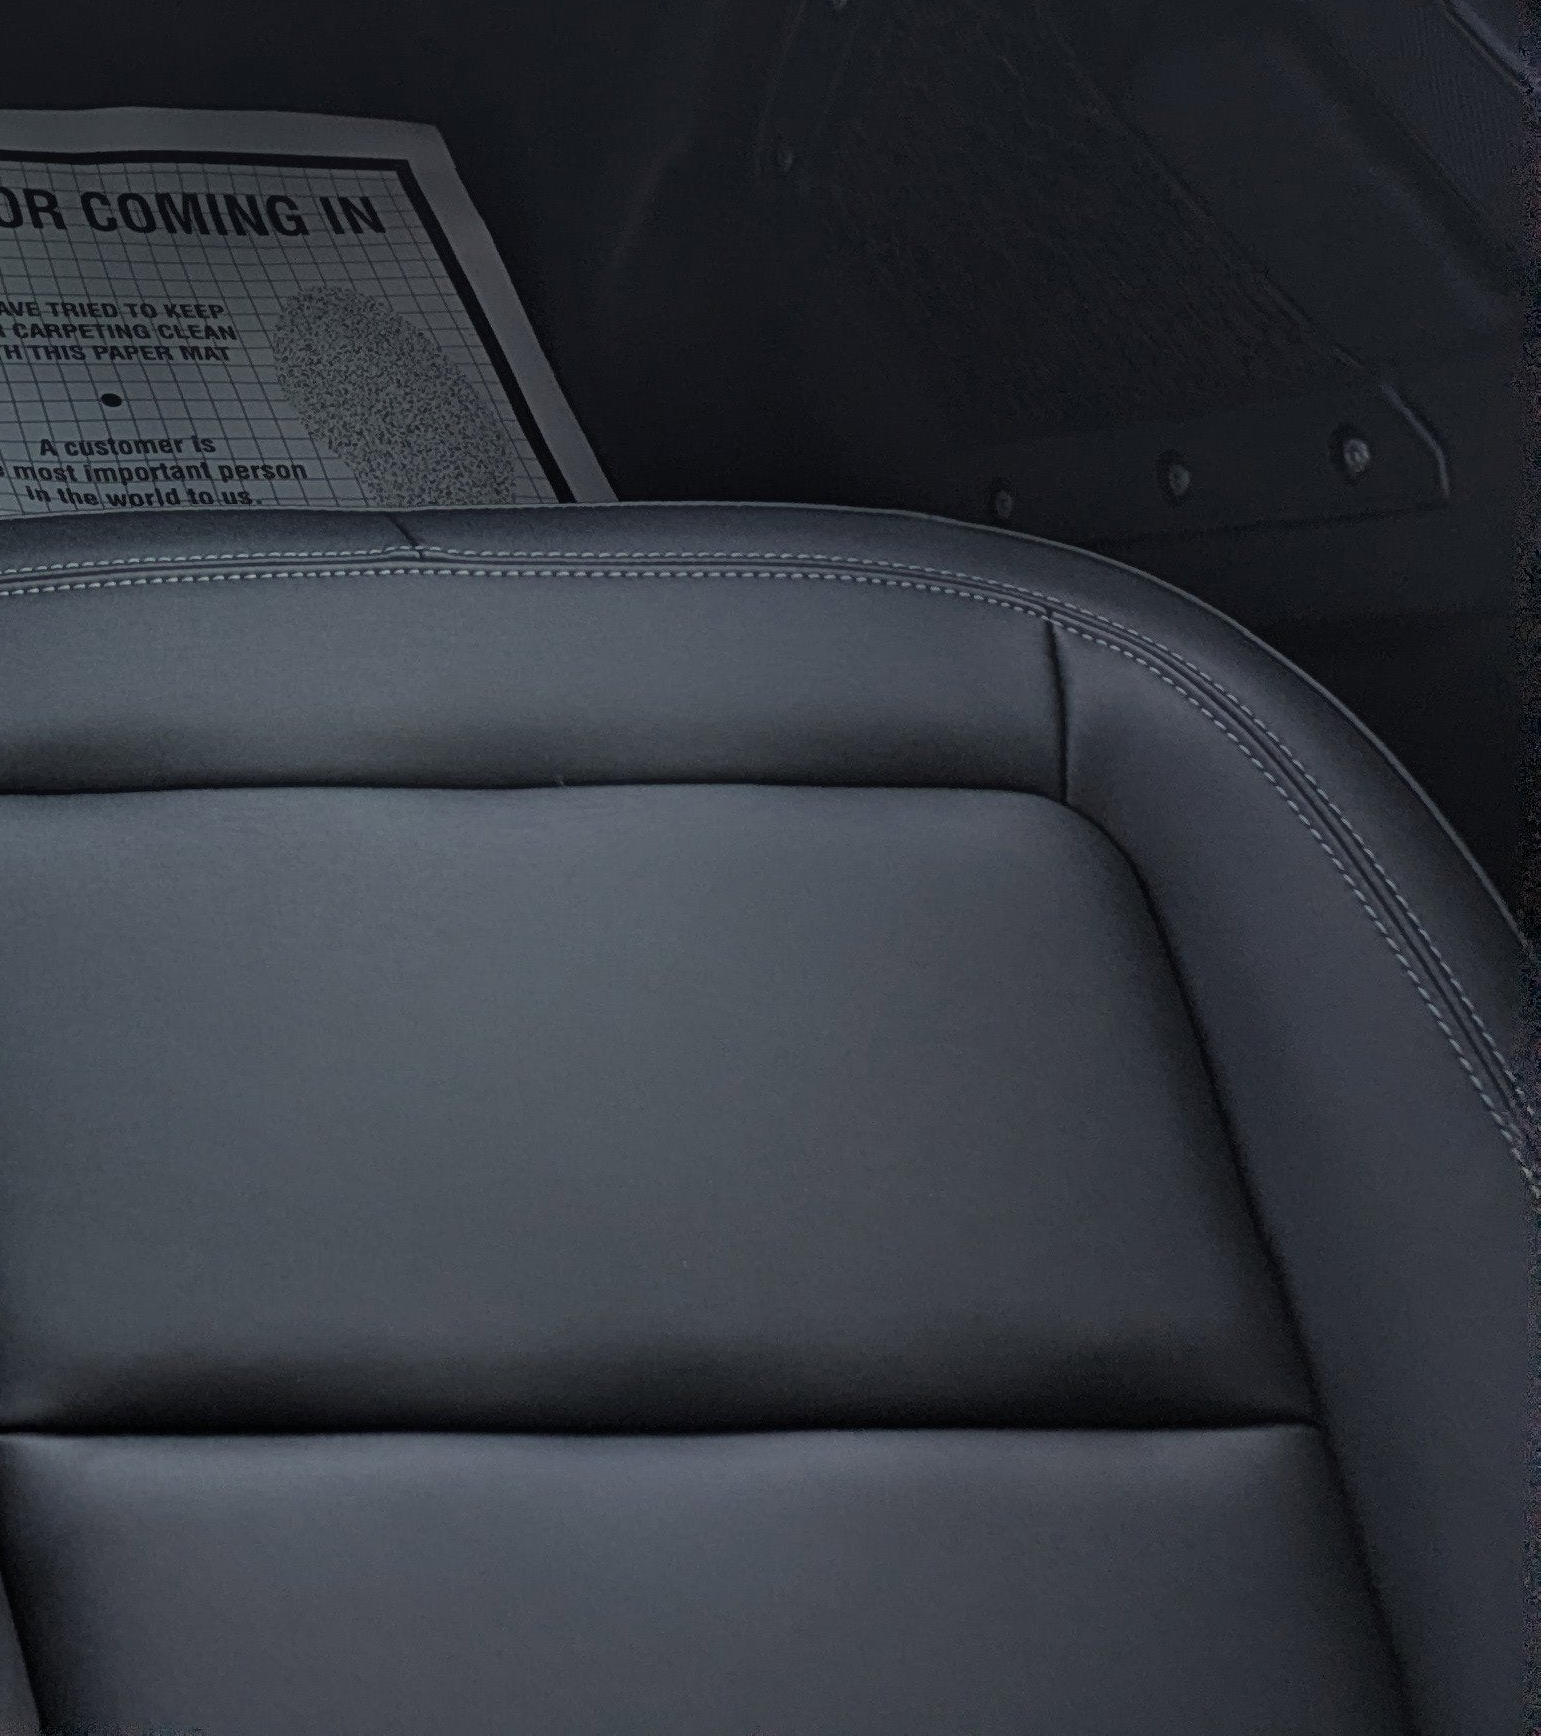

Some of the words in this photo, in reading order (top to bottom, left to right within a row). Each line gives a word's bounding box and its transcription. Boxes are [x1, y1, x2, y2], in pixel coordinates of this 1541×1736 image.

[80, 191, 310, 237] COMING
[319, 195, 386, 235] IN
[46, 302, 118, 318] TRIED
[123, 302, 158, 318] TO
[164, 303, 225, 319] KEEP
[12, 322, 152, 340] CARPETING
[158, 324, 237, 341] CLEAN
[27, 345, 86, 361] THIS
[94, 345, 173, 361] PAPER
[179, 346, 230, 361] MAT
[40, 439, 59, 456] A
[66, 437, 184, 456] customer
[193, 436, 217, 454] is
[17, 464, 78, 483] most
[85, 462, 211, 486] important
[218, 463, 308, 482] person
[26, 485, 51, 503] in
[57, 488, 99, 506] the
[106, 488, 181, 507] world
[187, 487, 214, 505] to
[222, 488, 263, 506] us.
